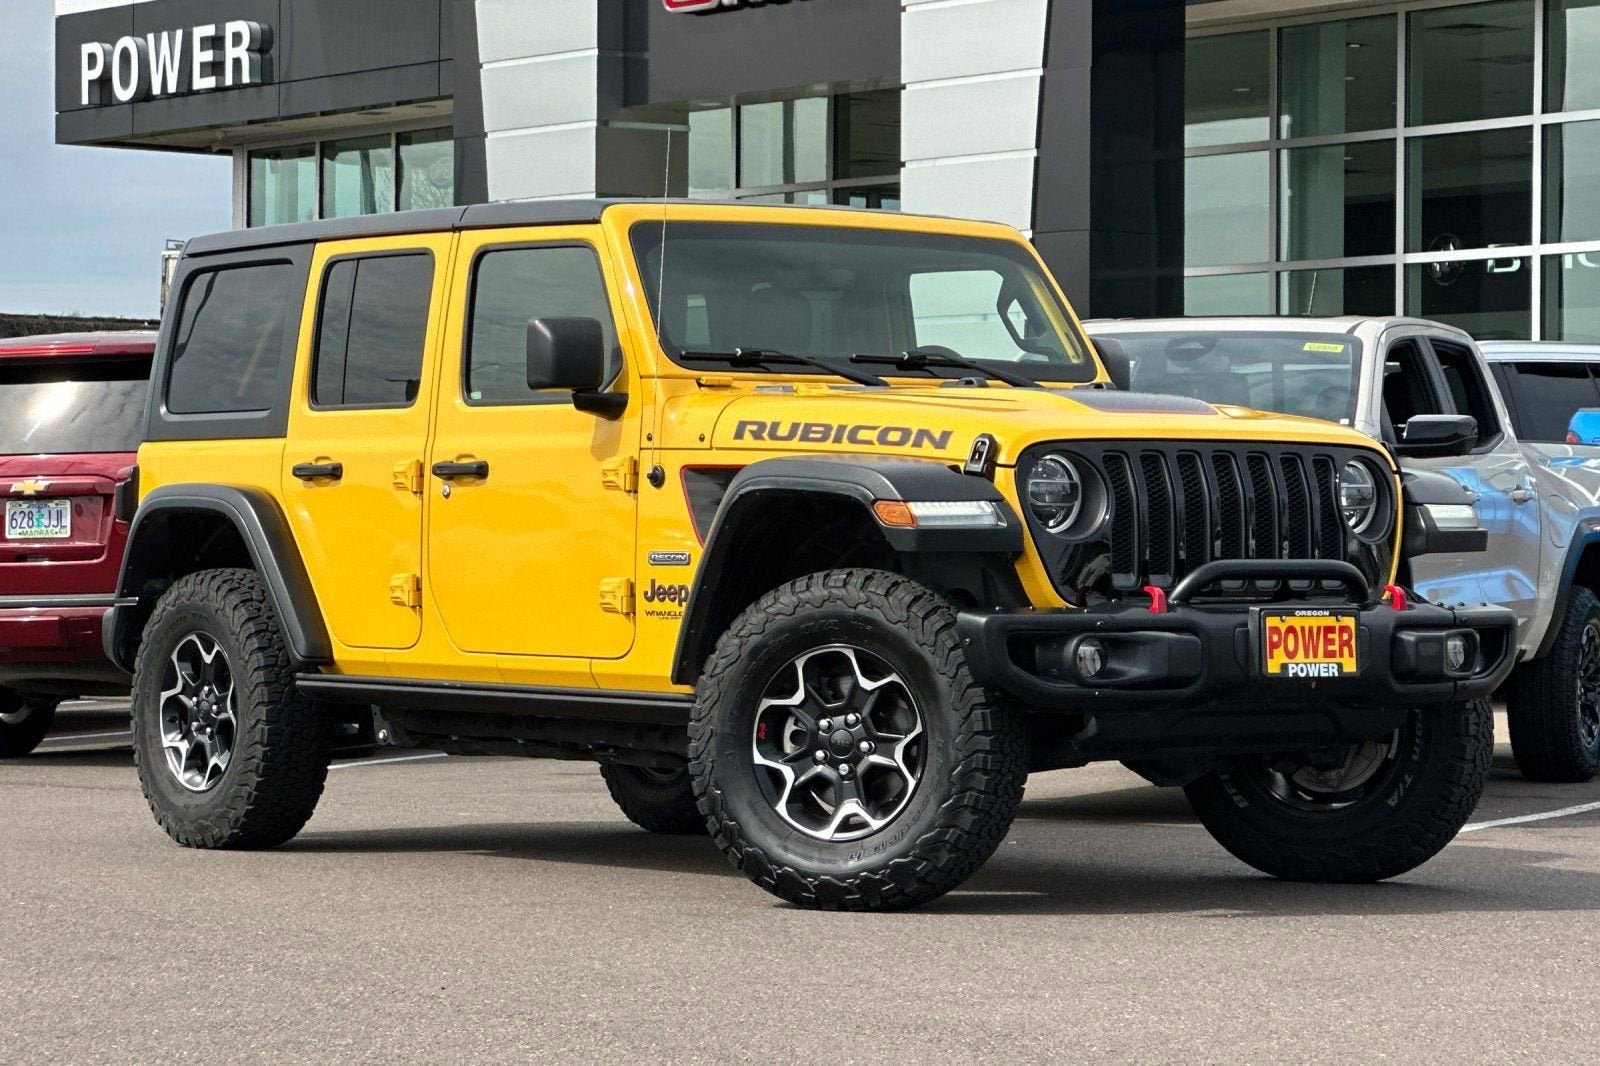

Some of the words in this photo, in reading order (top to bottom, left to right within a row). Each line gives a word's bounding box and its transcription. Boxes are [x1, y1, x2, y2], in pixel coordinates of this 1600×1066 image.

[80, 20, 251, 105] POWER
[733, 420, 954, 450] RUBICON
[10, 510, 34, 529] 628
[44, 509, 67, 528] JJL
[643, 579, 689, 607] Jeep
[1267, 624, 1354, 660] POWER
[1288, 663, 1339, 677] POWER
